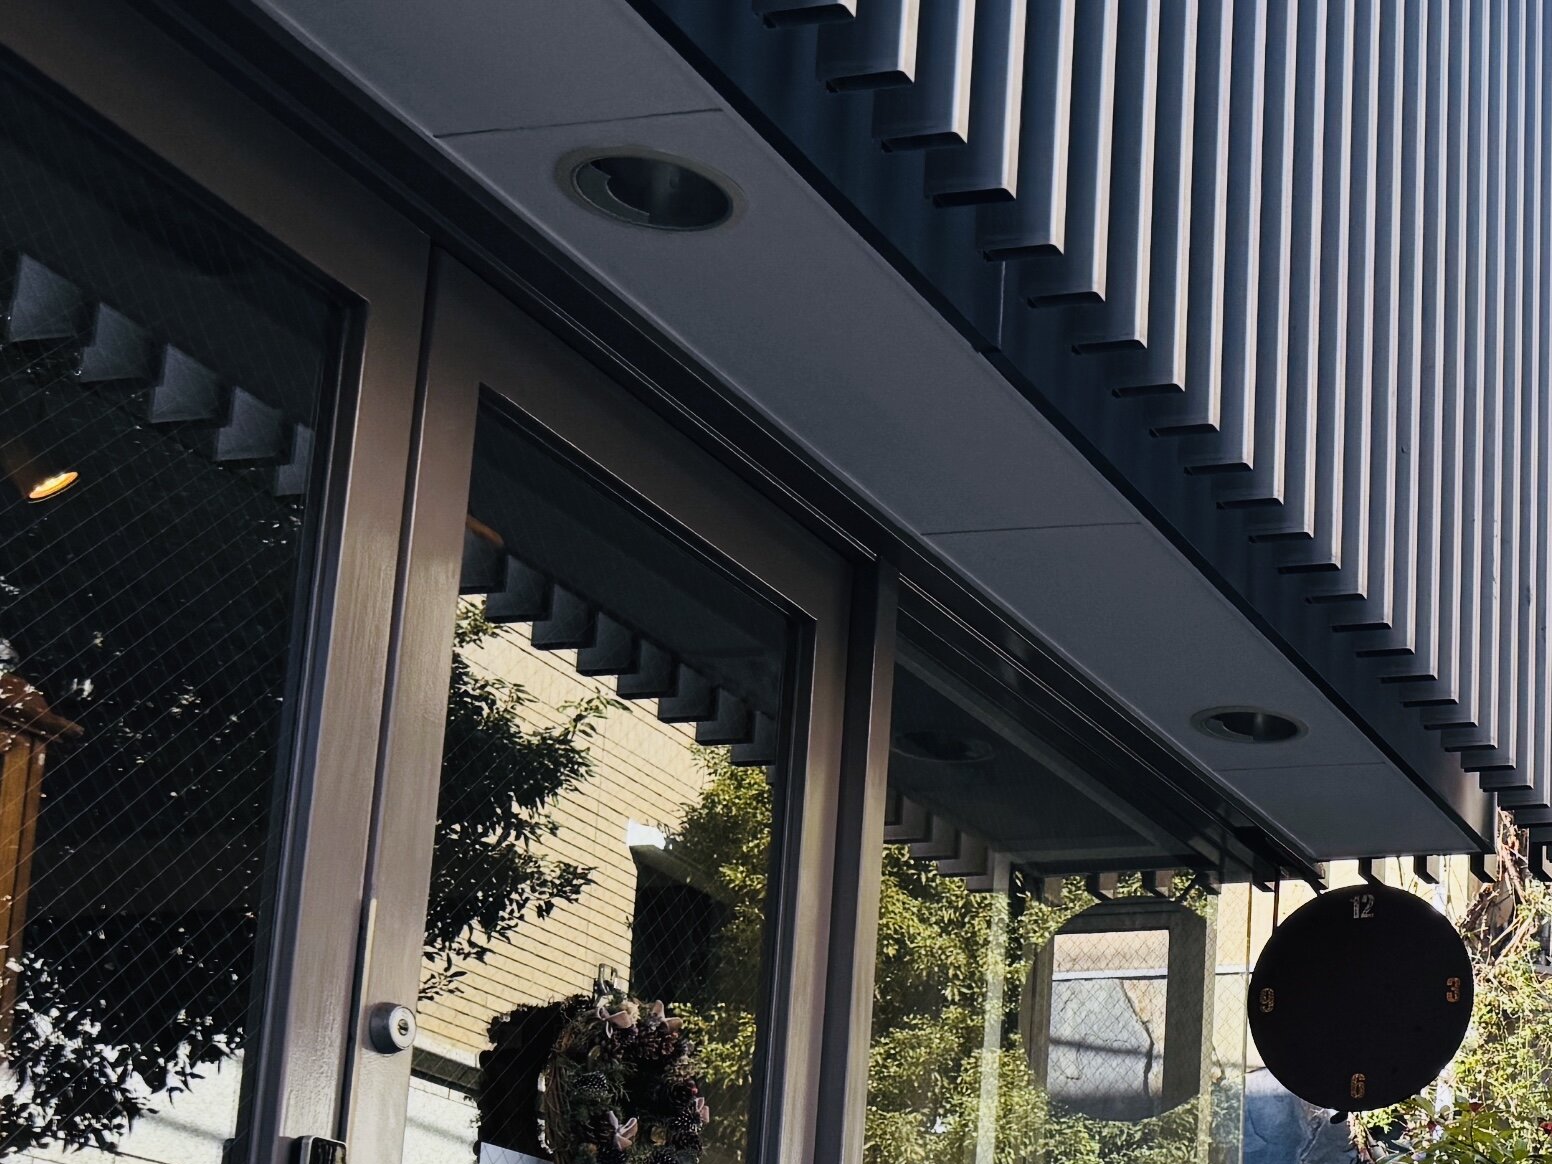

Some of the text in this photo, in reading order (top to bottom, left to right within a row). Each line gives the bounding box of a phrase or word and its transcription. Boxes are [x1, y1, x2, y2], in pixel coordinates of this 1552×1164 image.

[1350, 894, 1375, 919] 12
[1260, 987, 1275, 1013] 9
[1446, 977, 1461, 1003] 3
[1351, 1073, 1366, 1099] 6
